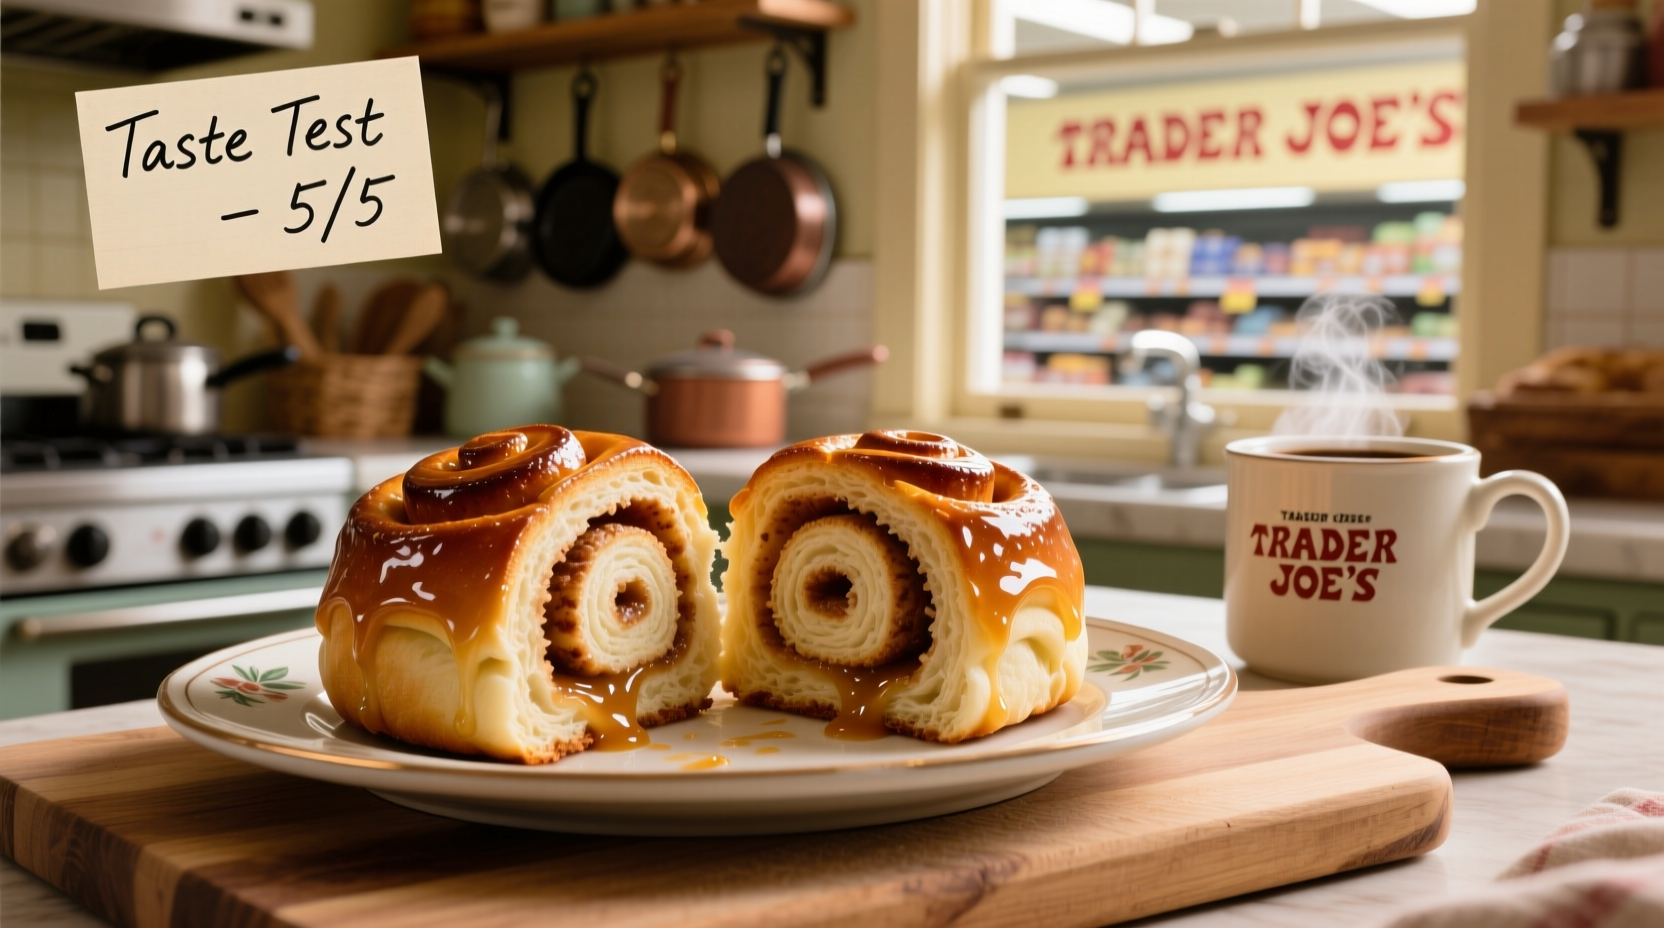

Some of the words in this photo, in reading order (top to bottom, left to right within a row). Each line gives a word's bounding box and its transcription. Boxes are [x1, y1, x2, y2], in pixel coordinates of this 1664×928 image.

[105, 109, 253, 179] Taste
[270, 94, 385, 157] Test
[1058, 108, 1265, 170] TRADER
[1286, 89, 1463, 154] JOE'S
[283, 165, 396, 244] 5/5
[1250, 523, 1398, 564] TRADER
[1269, 564, 1380, 602] JOE'S
